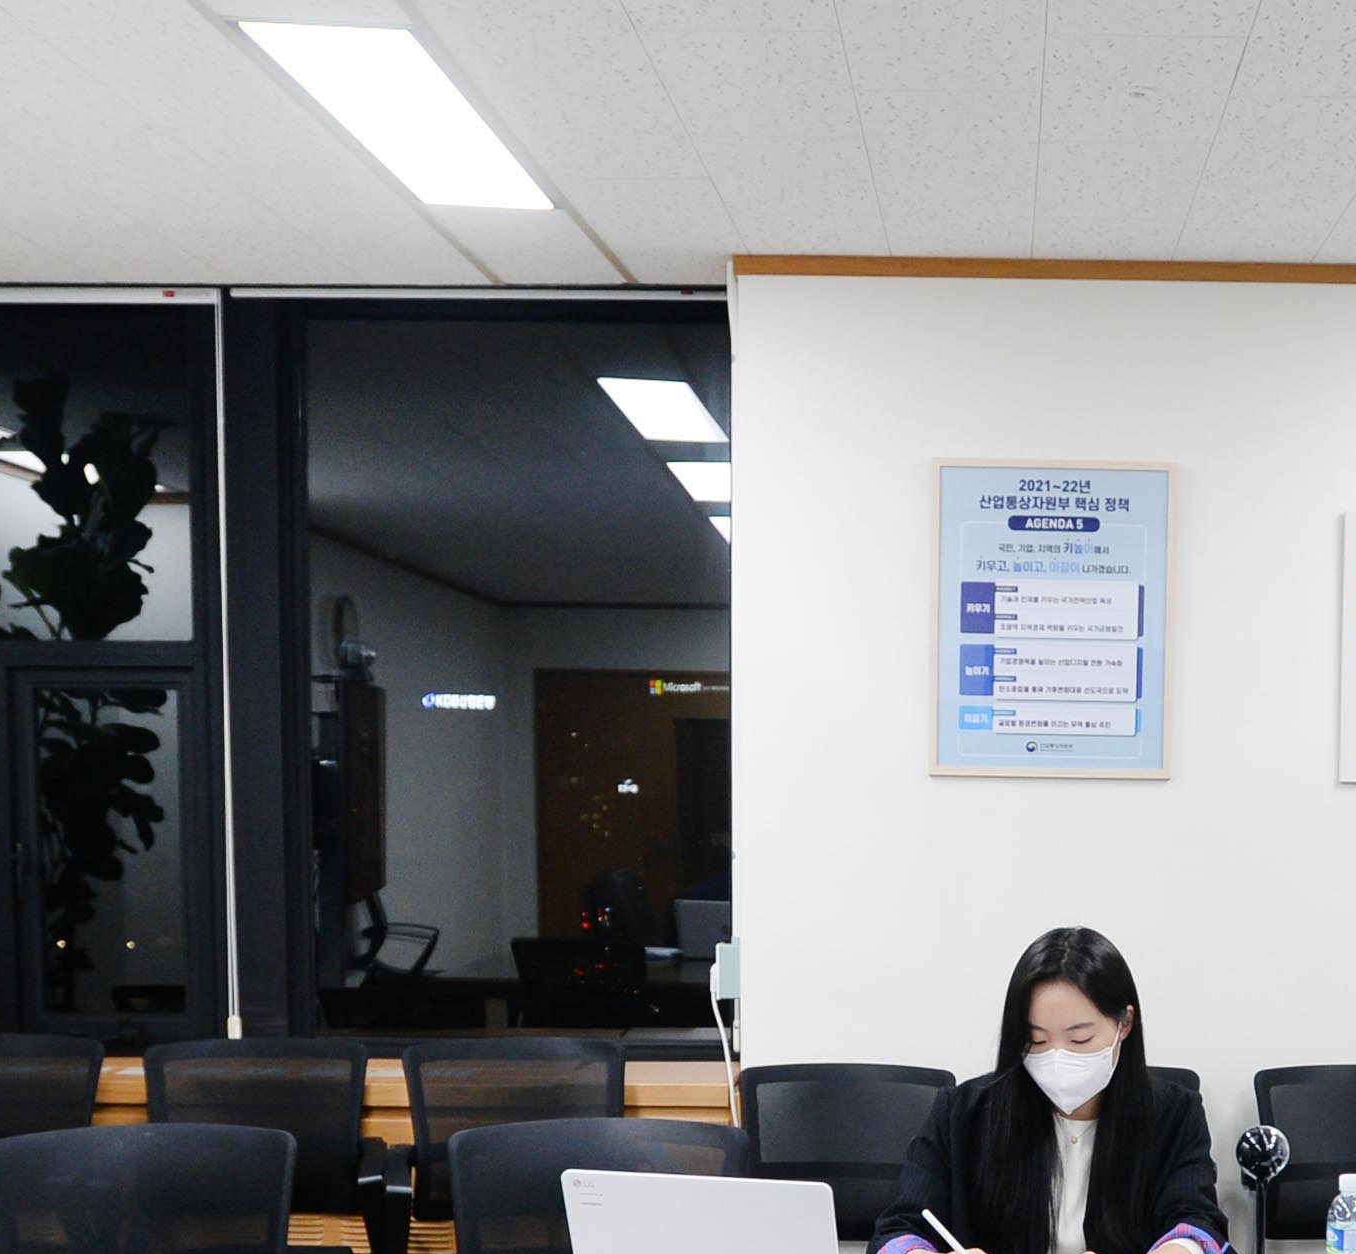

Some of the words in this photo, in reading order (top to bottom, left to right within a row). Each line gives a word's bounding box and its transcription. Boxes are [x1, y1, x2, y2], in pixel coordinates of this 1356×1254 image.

[1018, 480, 1092, 494] 2021~22년
[979, 495, 1070, 511] 산업통상자원부
[1074, 497, 1100, 512] 핵심
[1104, 498, 1130, 512] 정책
[1025, 518, 1074, 529] AGENDA
[1076, 519, 1084, 530] 5
[976, 559, 1010, 572] 키우고,
[663, 682, 702, 692] Microsoft
